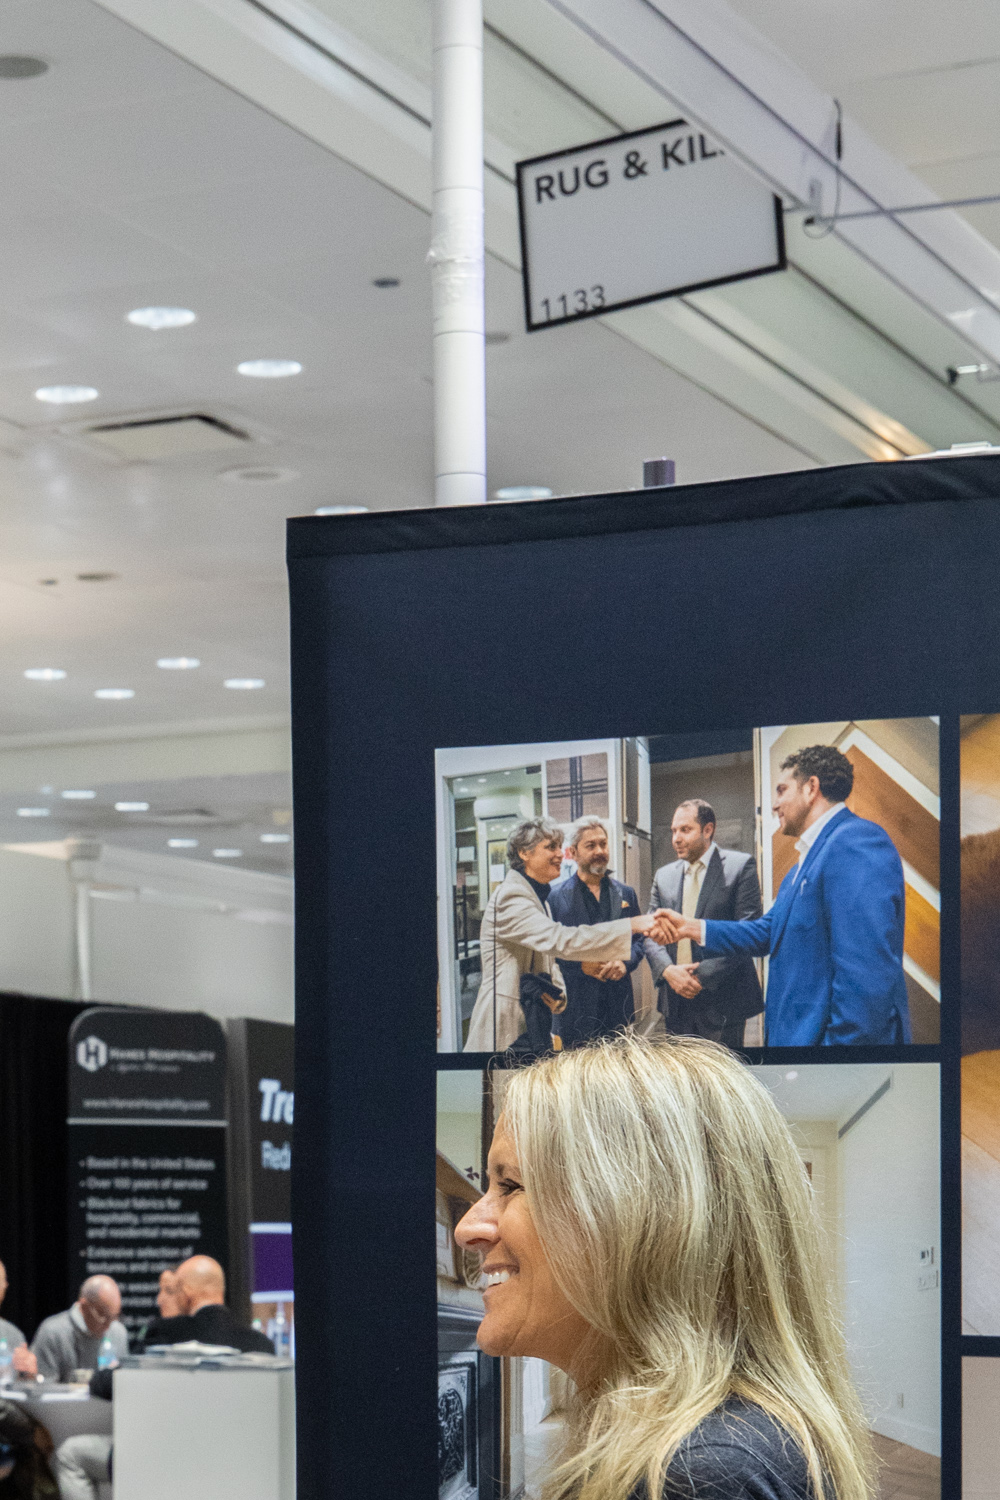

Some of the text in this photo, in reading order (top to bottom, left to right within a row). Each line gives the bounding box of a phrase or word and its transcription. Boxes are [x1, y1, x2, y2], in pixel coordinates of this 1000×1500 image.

[534, 132, 725, 204] RUG & KIL
[540, 285, 606, 321] 1133
